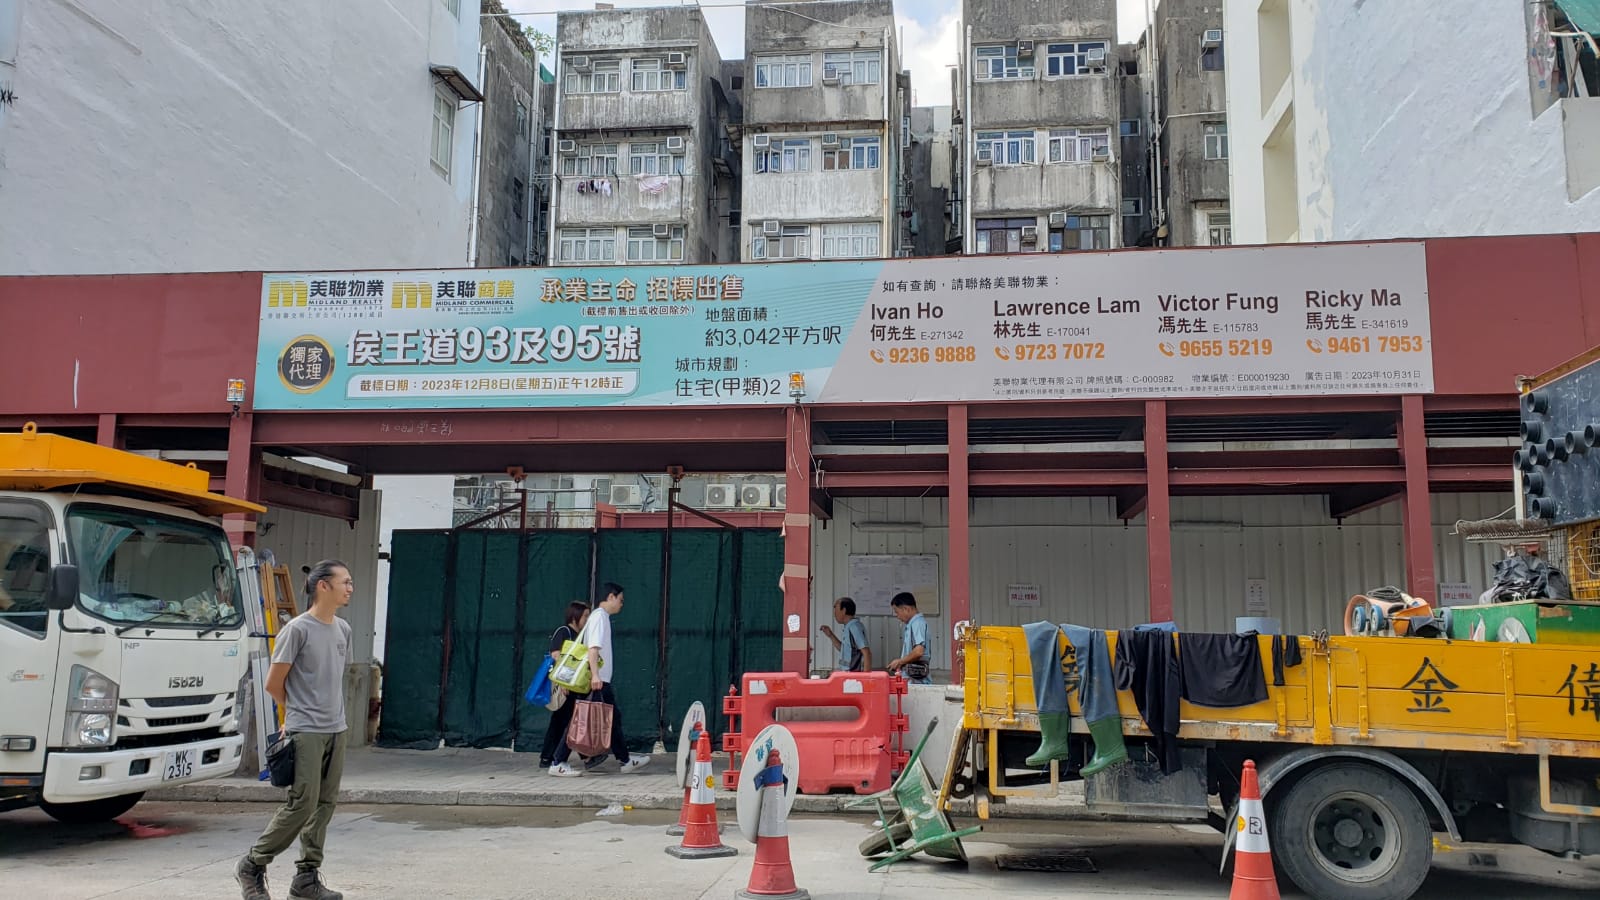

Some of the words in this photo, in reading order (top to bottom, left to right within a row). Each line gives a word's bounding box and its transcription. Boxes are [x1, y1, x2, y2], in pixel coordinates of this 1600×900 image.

[309, 280, 384, 297] 美聯物業
[436, 280, 514, 298] 美聯商業
[540, 277, 637, 302] 承業主命
[647, 274, 745, 301] 招標出售
[994, 299, 1090, 318] Lawrence
[1098, 296, 1140, 314] Lam
[1158, 294, 1220, 312] Victor
[1226, 292, 1279, 314] Fung
[1306, 290, 1364, 311] Ricky
[1372, 289, 1401, 306] Ma
[705, 308, 779, 322] 地盤面積：
[871, 303, 910, 320] Ivan
[918, 302, 944, 319] Ho
[994, 320, 1041, 338] 林先生
[1047, 327, 1090, 337] E-170041
[1158, 316, 1208, 334] 馮先生
[1213, 322, 1258, 333] E-115783
[1306, 312, 1356, 330] 馬先生
[1362, 319, 1408, 329] E-341619
[705, 326, 842, 348] 約3,042平方呎
[870, 324, 916, 341] 何先生
[920, 330, 964, 340] E-271342
[346, 325, 642, 366] 侯王道93及95號
[1016, 344, 1056, 360] 9723
[1063, 342, 1104, 360] 7072
[1180, 340, 1222, 357] 9655
[1228, 339, 1272, 356] 5219
[1328, 336, 1370, 354] 9461
[1378, 336, 1423, 352] 7953
[290, 347, 323, 362] 獨家
[890, 347, 929, 363] 9236
[936, 346, 976, 362] 9888
[289, 364, 322, 380] 代理
[675, 356, 748, 372] 城市規劃：
[675, 377, 780, 398] 住宅(甲類)2
[994, 376, 1083, 386] 美聯物業代理有限公司
[168, 676, 204, 688] ISUZU
[1400, 656, 1459, 712] 金
[176, 750, 188, 764] WK
[168, 762, 192, 780] 2315
